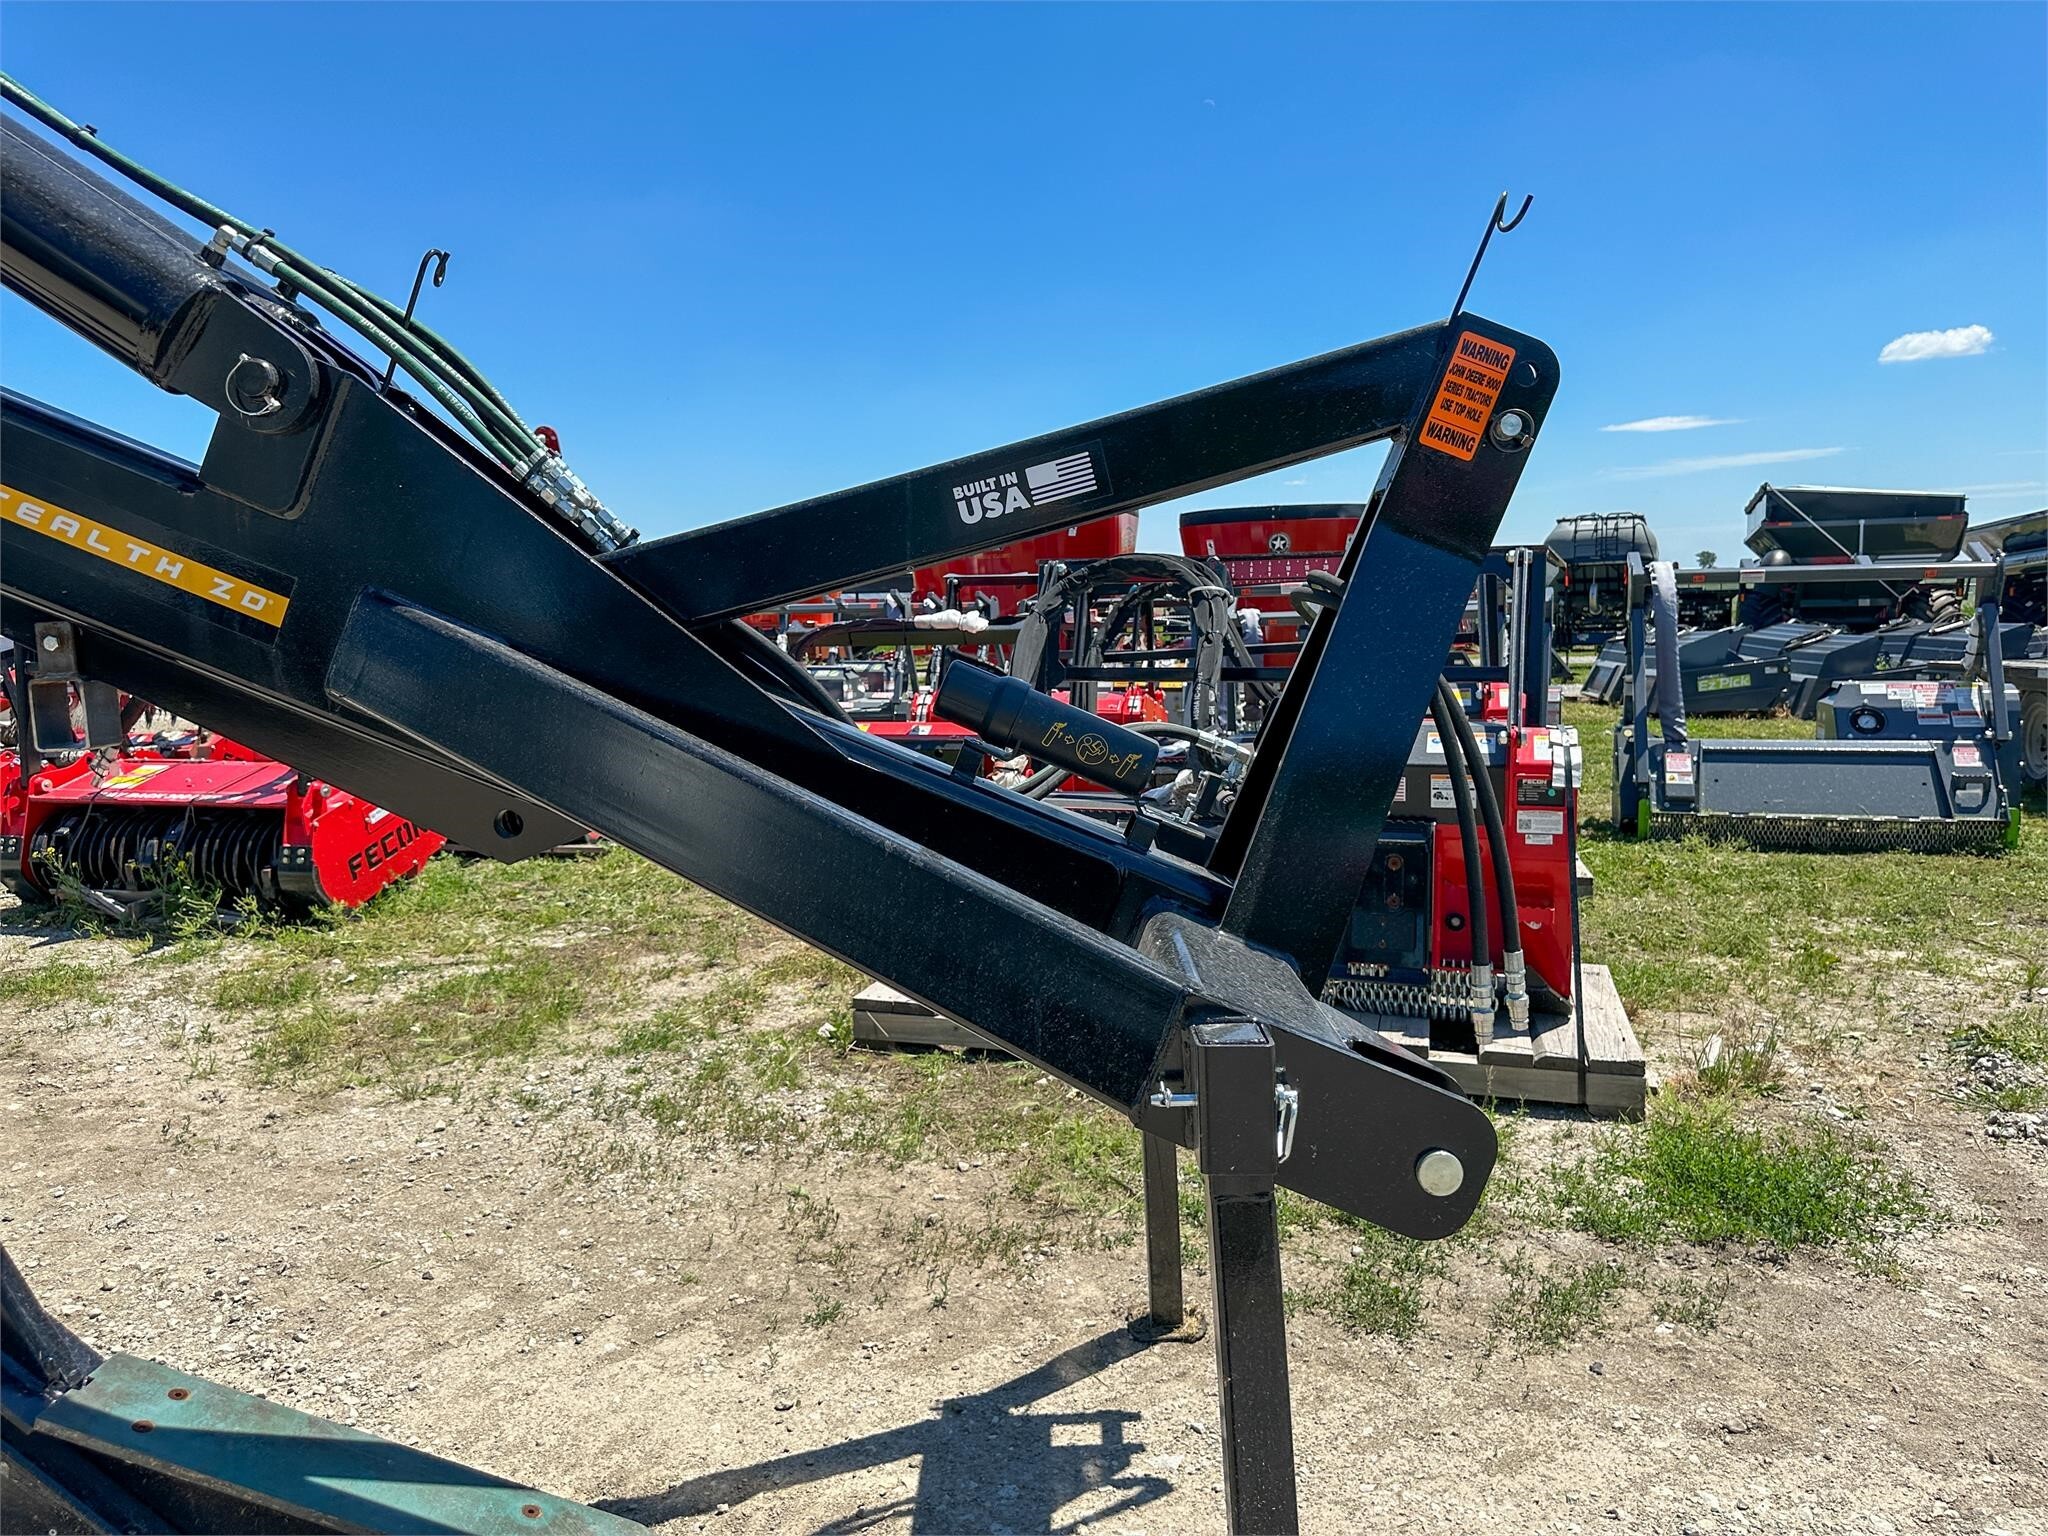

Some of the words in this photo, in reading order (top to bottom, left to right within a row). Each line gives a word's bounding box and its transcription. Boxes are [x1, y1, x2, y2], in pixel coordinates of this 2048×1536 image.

[1460, 338, 1510, 371] WARNING
[1448, 362, 1465, 379] JOHN
[1465, 367, 1488, 386] DEERE
[1485, 374, 1502, 392] 9000
[438, 385, 474, 420] GH781-8
[1443, 379, 1465, 397] SERIES
[1463, 386, 1493, 408] TRACTORS
[1439, 397, 1453, 413] USE
[1453, 402, 1467, 417] TOP
[1465, 406, 1483, 424] HOLE
[1425, 421, 1476, 453] WARNING
[952, 477, 996, 500] BUILT
[999, 471, 1018, 487] IN
[956, 486, 1031, 525] USA
[1193, 701, 1201, 720] MSHA
